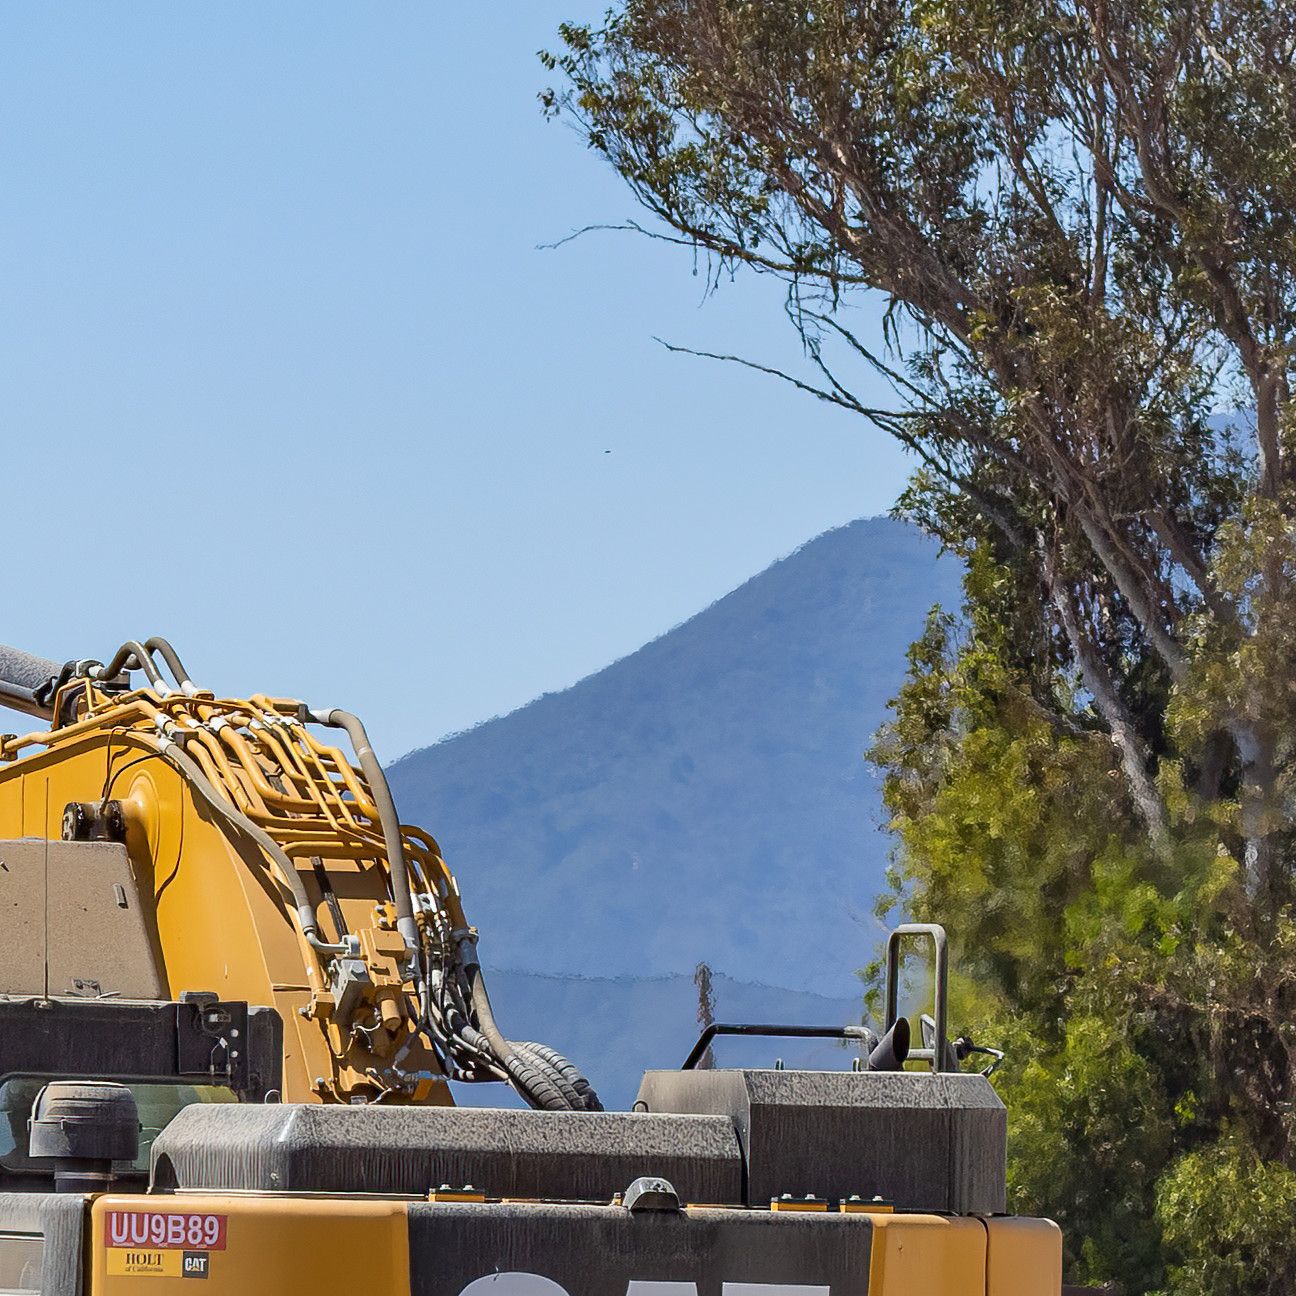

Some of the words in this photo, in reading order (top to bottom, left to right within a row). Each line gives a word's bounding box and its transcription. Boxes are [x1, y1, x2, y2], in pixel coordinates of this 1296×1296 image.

[111, 1212, 219, 1245] UU9B89
[125, 1253, 164, 1265] HOLT
[184, 1257, 207, 1272] CAT
